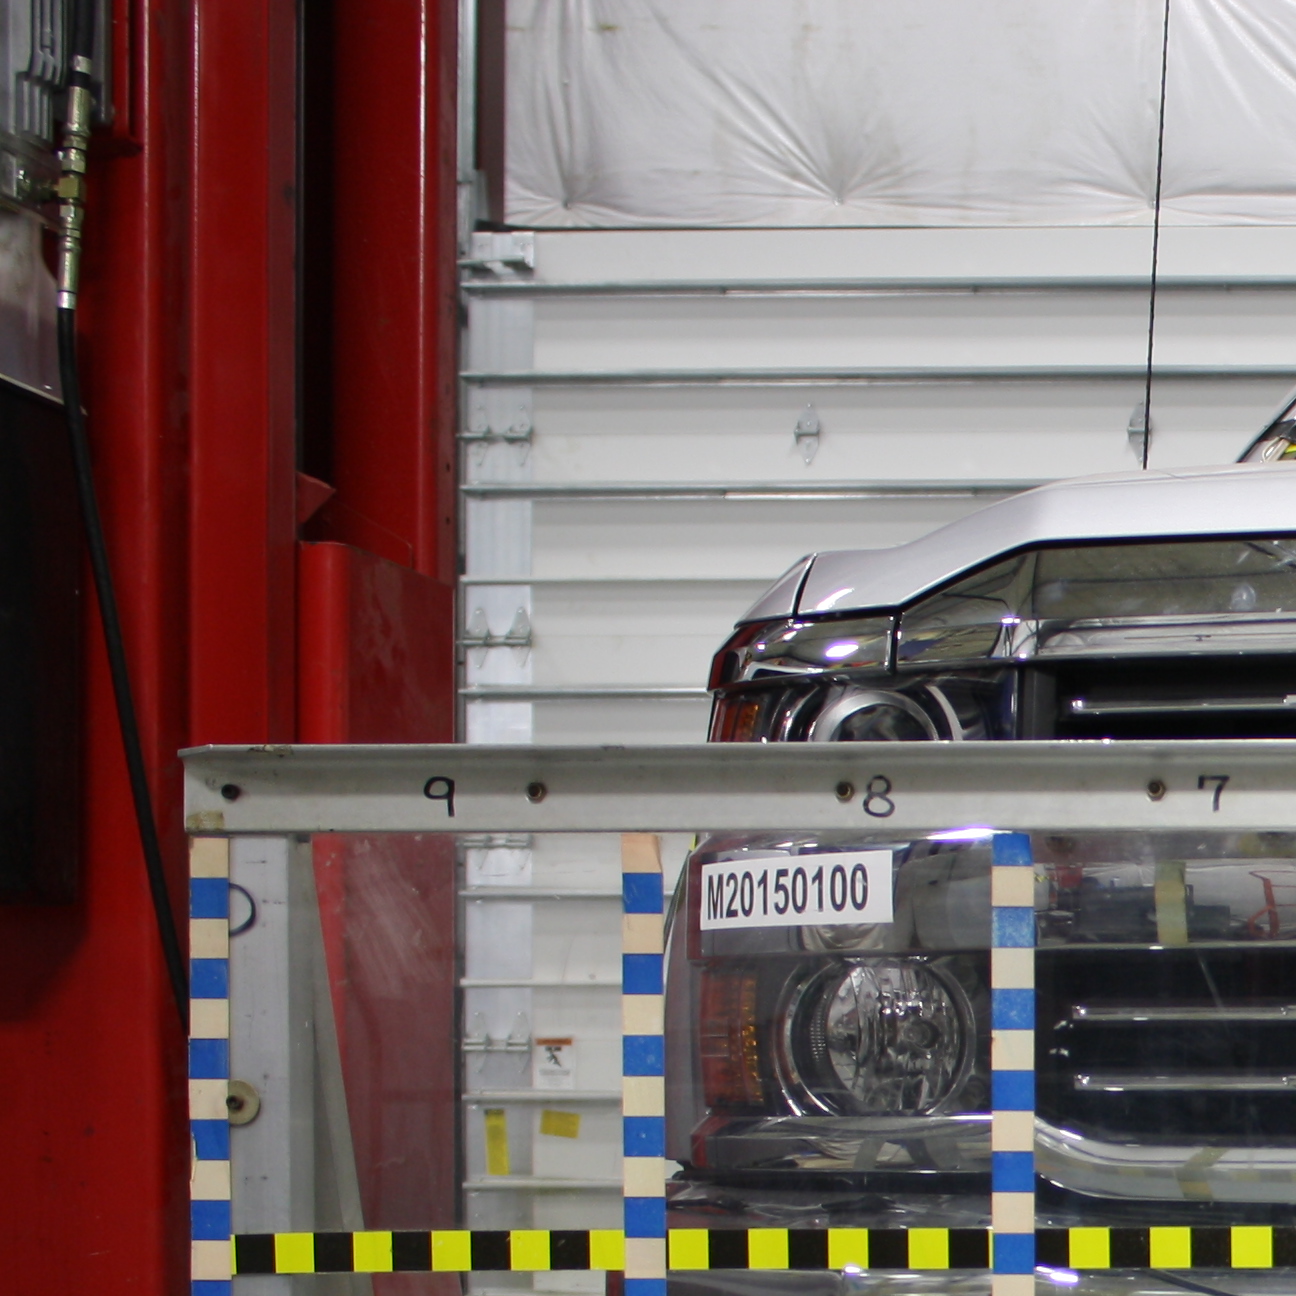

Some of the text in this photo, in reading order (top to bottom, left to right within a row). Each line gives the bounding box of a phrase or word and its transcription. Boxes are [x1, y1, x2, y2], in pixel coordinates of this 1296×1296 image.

[423, 775, 458, 818] 9
[862, 774, 895, 818] 8
[1196, 774, 1232, 814] 7
[706, 862, 870, 921] M20150100
